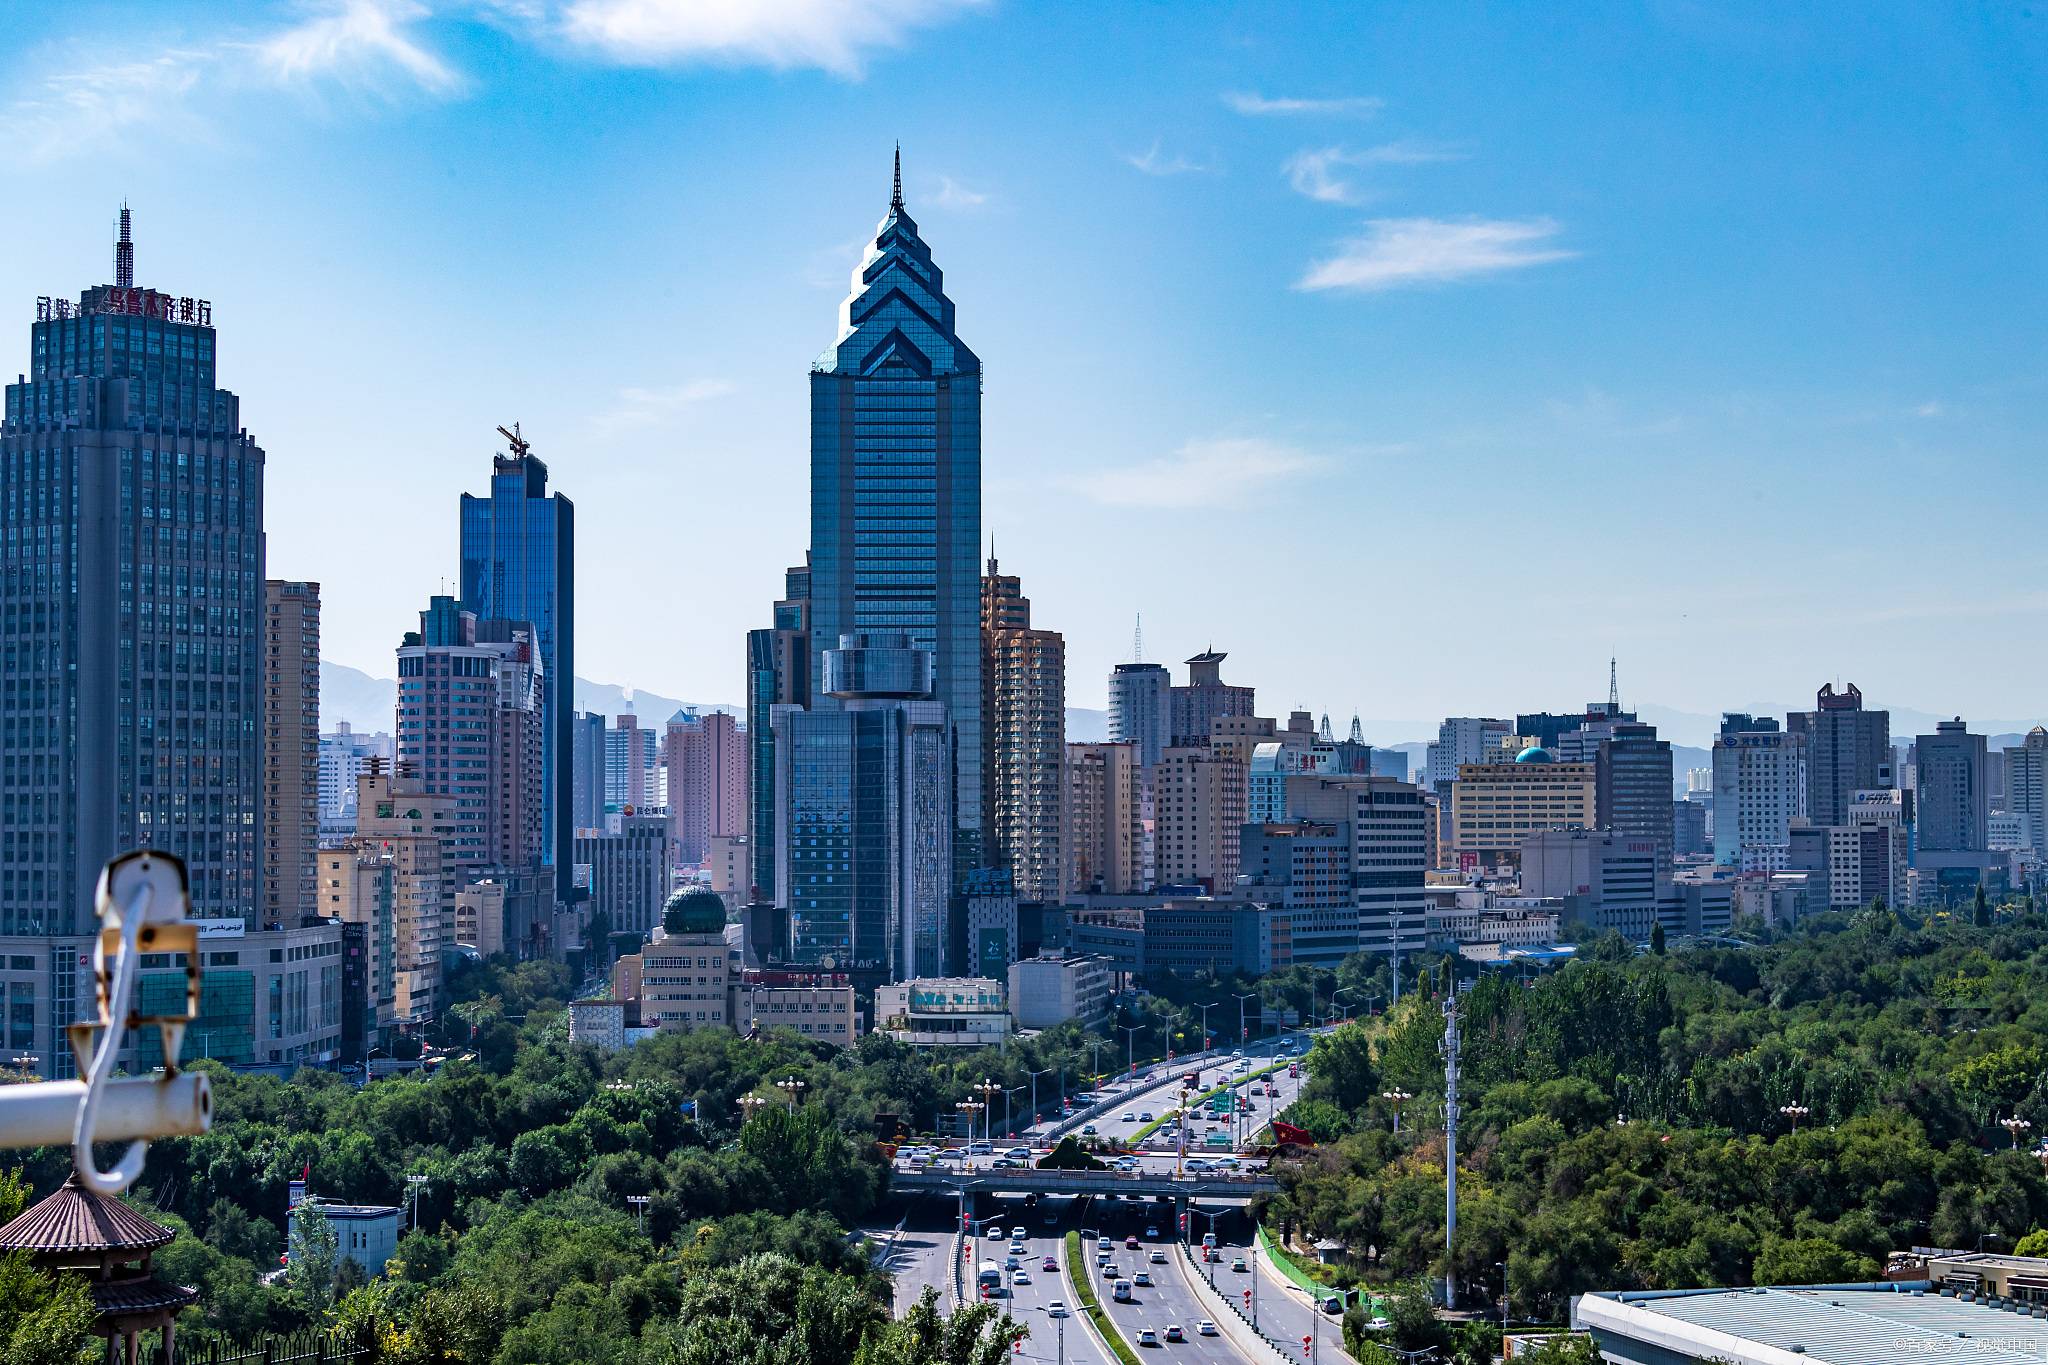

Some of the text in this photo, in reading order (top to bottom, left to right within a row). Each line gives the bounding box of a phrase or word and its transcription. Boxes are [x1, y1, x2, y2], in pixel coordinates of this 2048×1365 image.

[110, 288, 212, 325] 乌鲁木齐银行
